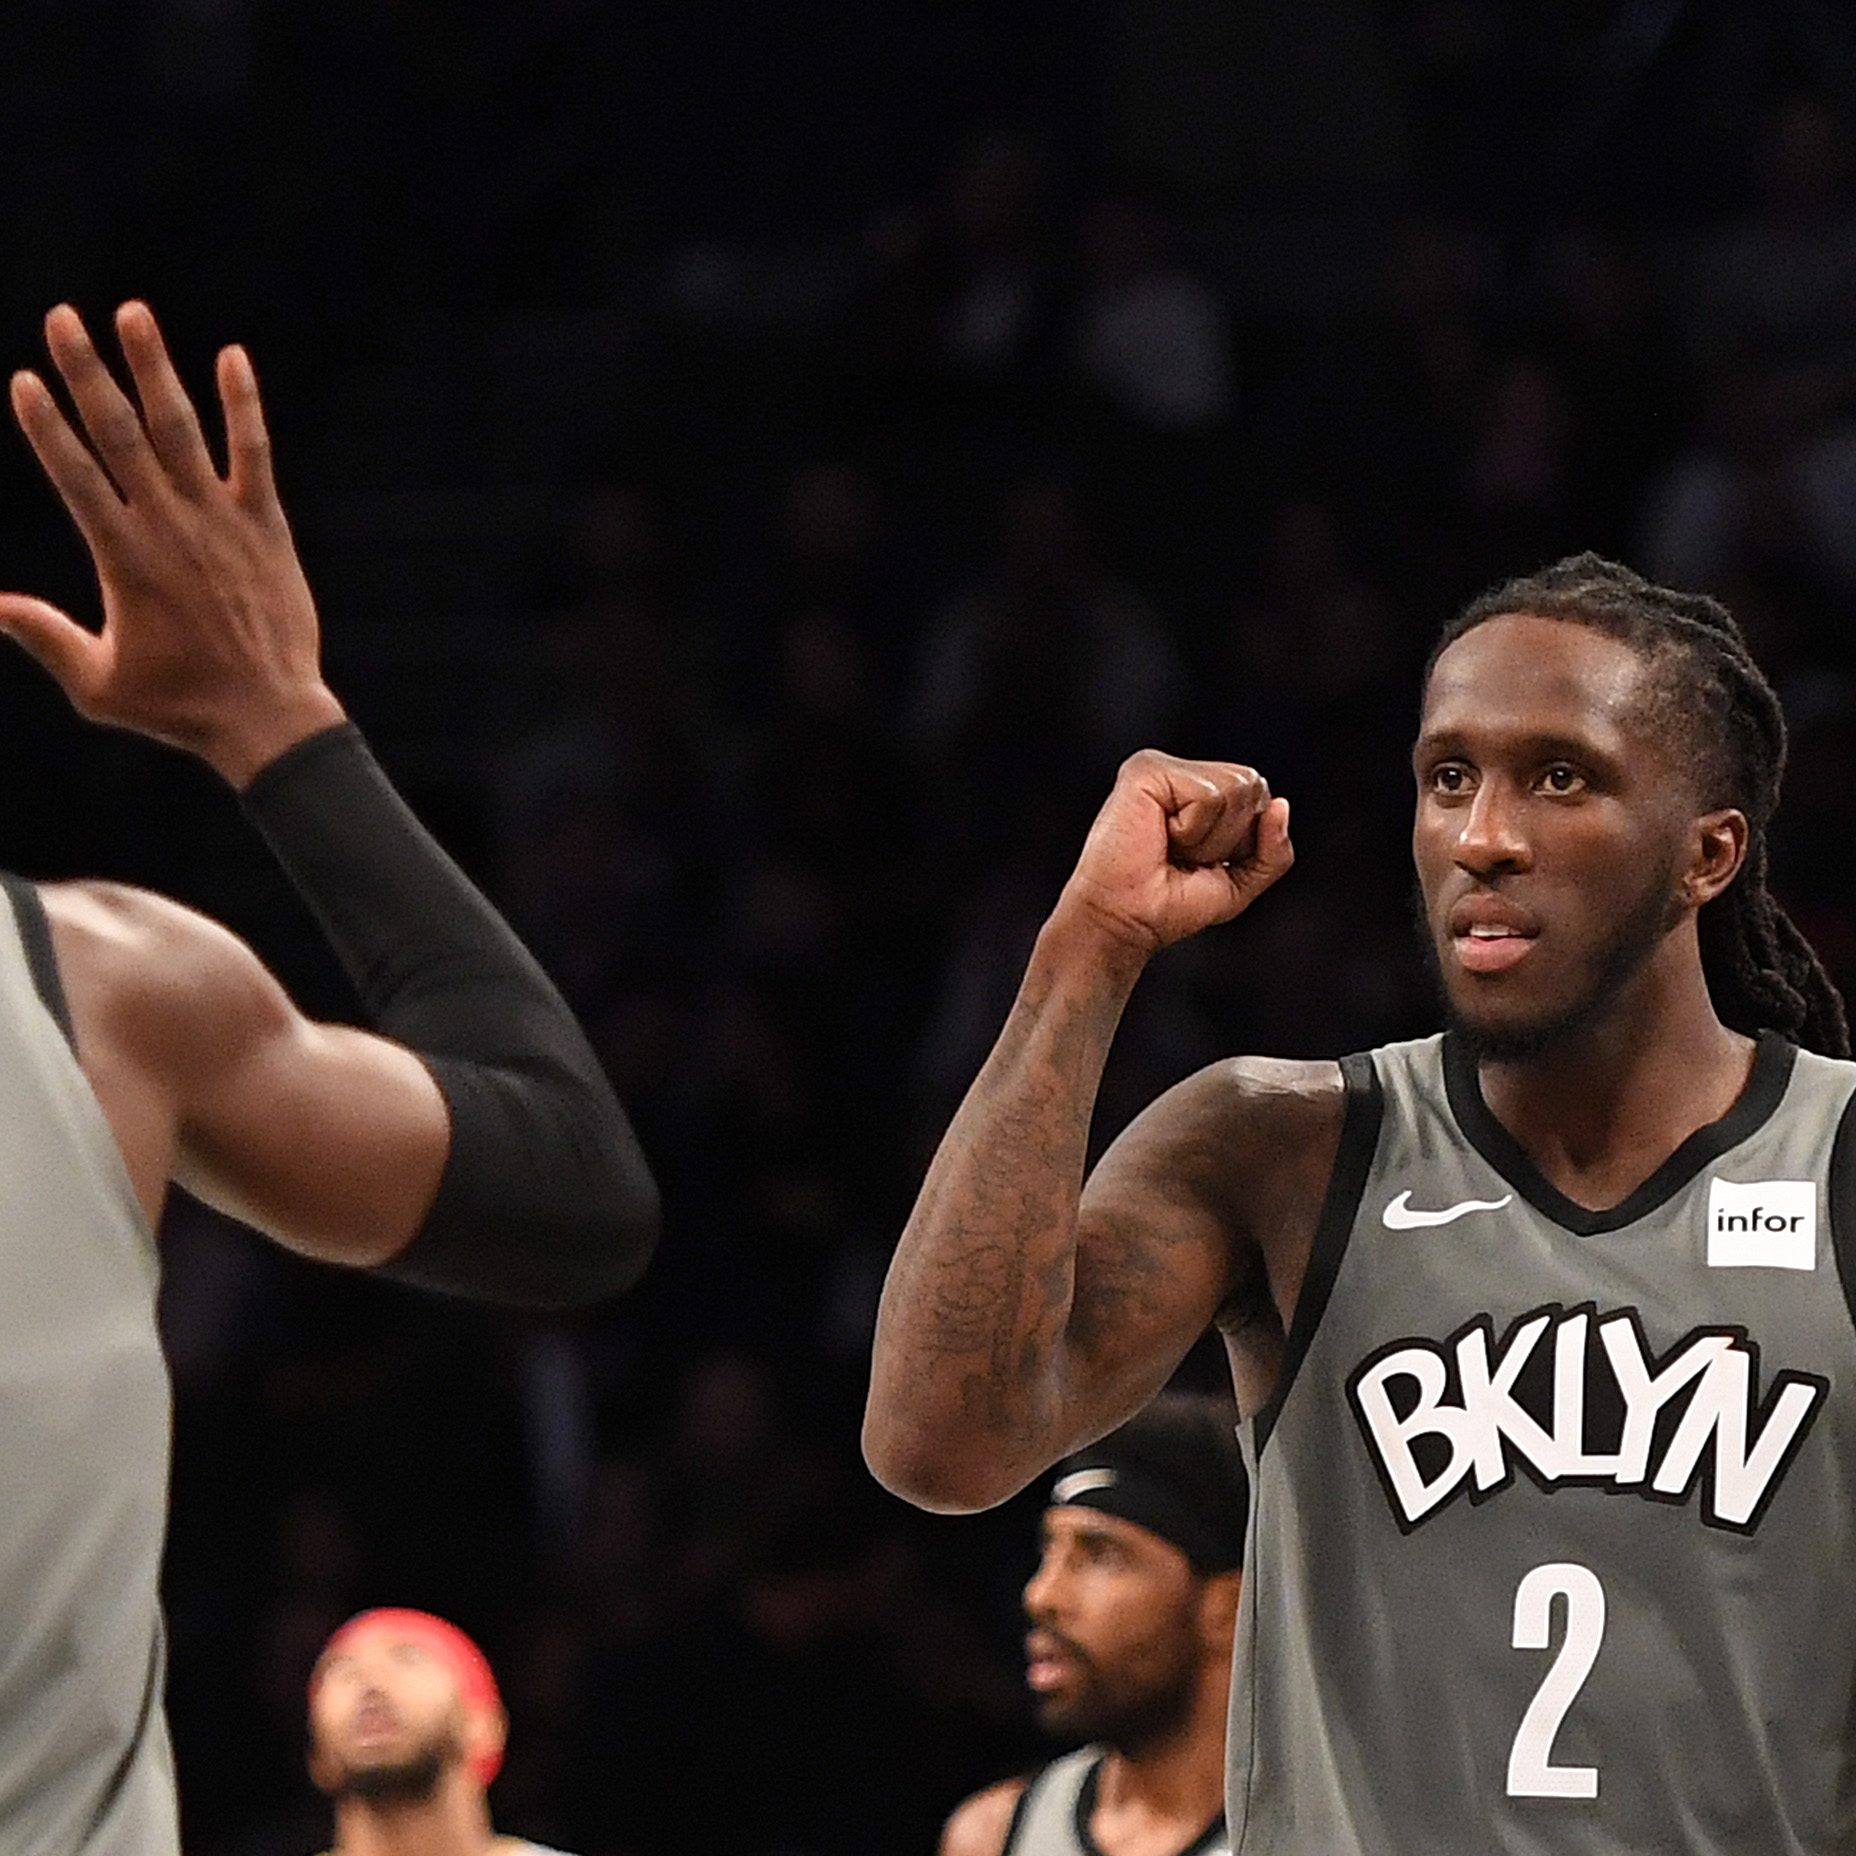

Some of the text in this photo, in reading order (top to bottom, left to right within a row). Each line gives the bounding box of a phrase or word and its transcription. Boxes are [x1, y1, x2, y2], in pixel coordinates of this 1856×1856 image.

[1717, 1206, 1806, 1234] infor
[1350, 1304, 1826, 1532] BKLYN
[1506, 1562, 1606, 1799] 2
